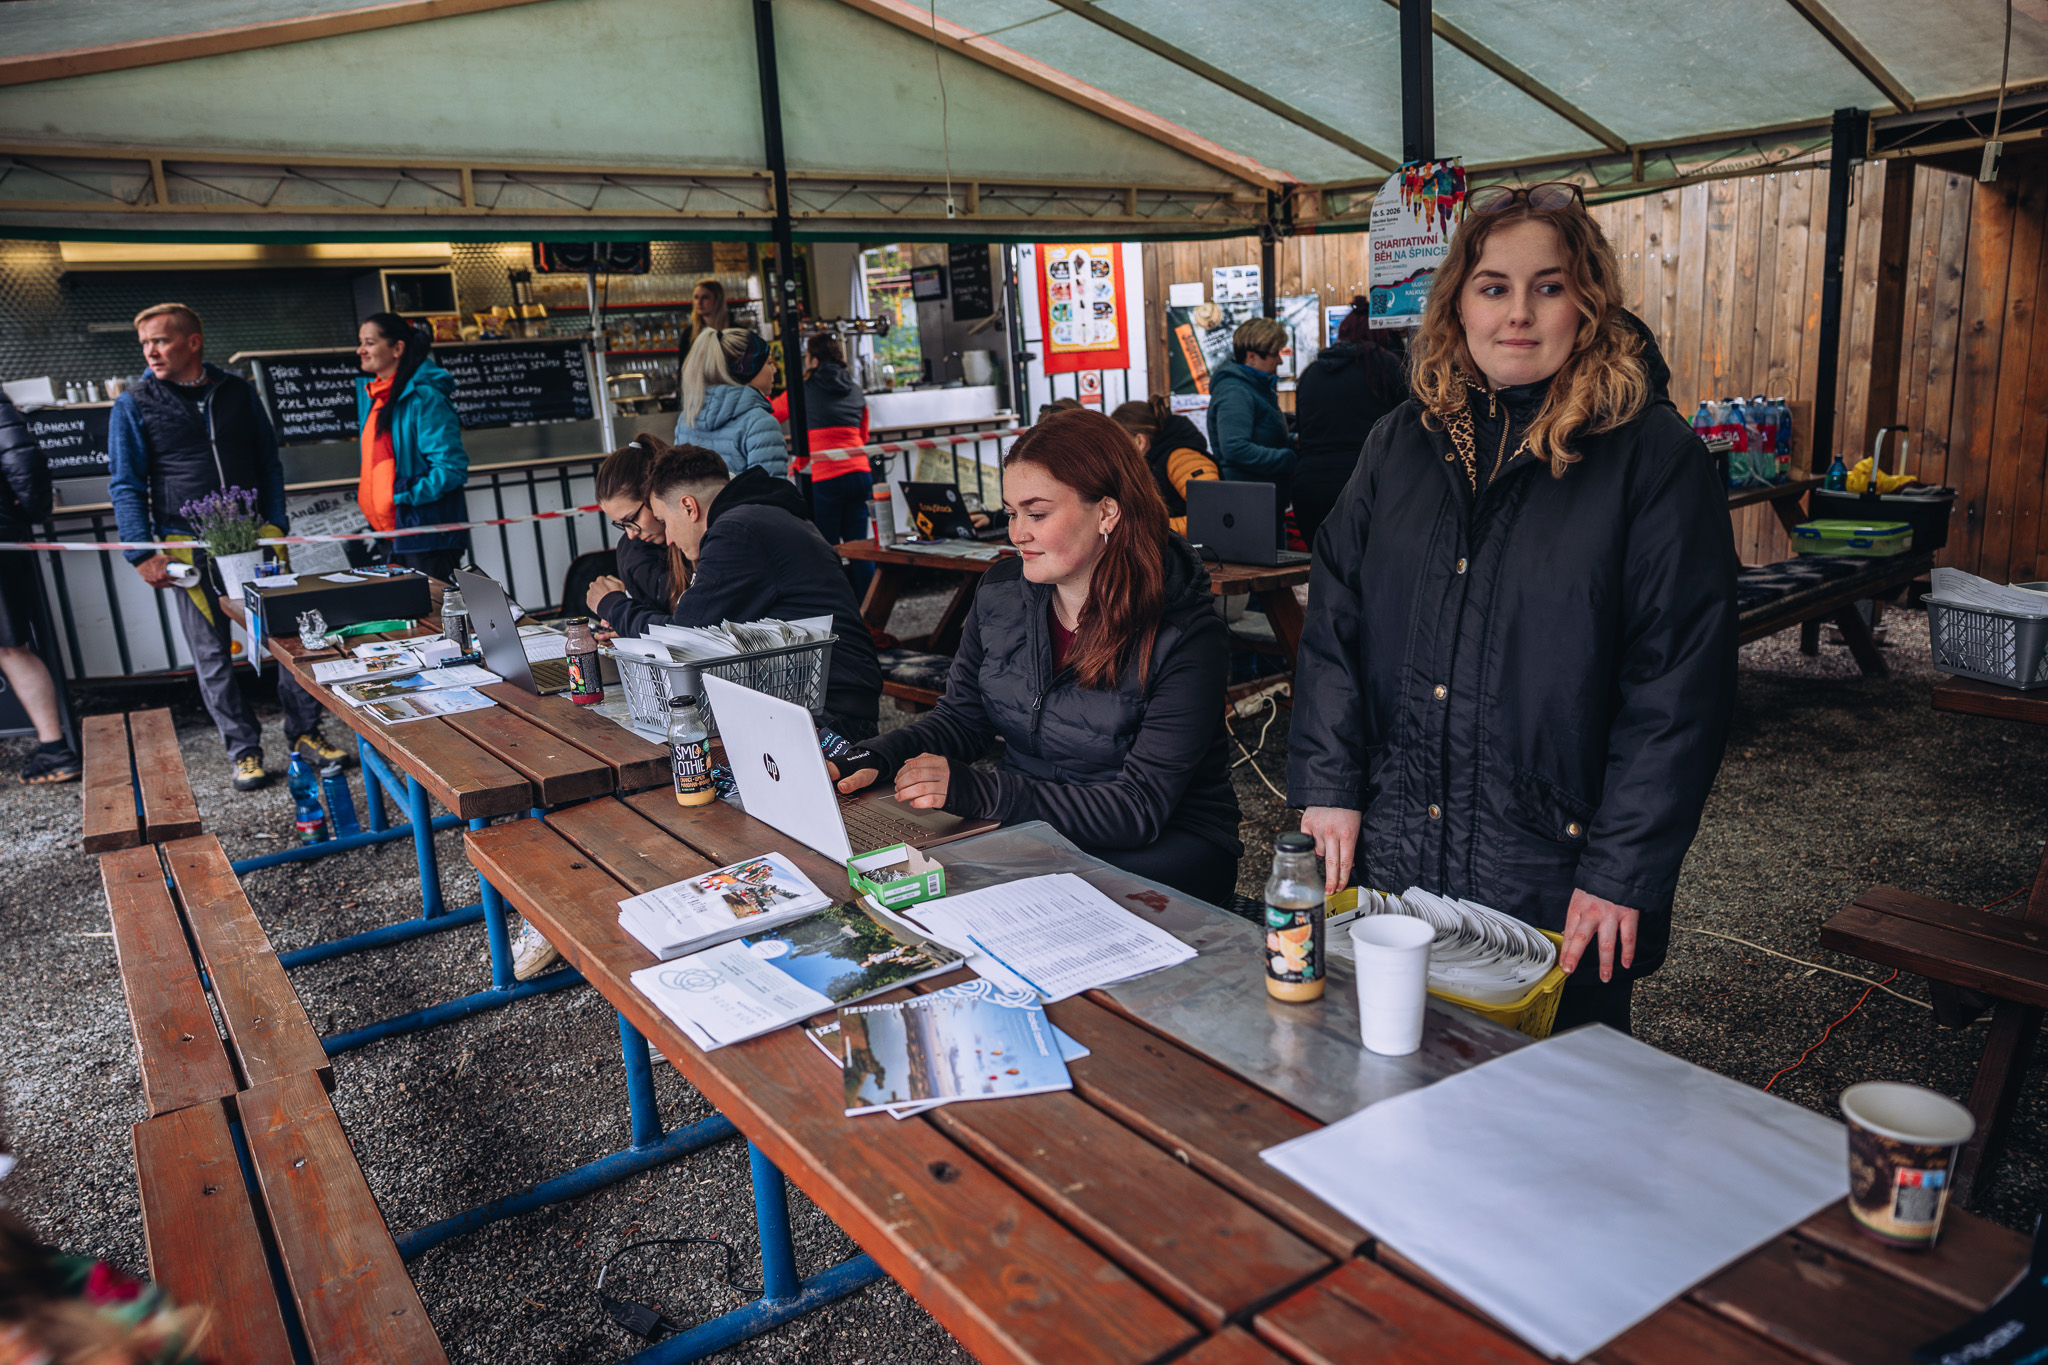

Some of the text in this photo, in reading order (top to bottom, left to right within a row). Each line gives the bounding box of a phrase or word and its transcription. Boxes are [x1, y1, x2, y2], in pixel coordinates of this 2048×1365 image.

[1386, 207, 1401, 215] 2026
[1374, 233, 1438, 250] CHARITATIVNÍ
[1374, 246, 1448, 262] BĚH NA ŠPINCE
[277, 398, 306, 410] XXL
[38, 435, 84, 450] ROKETY
[828, 740, 850, 758] #KDY
[678, 757, 706, 776] OTHIE
